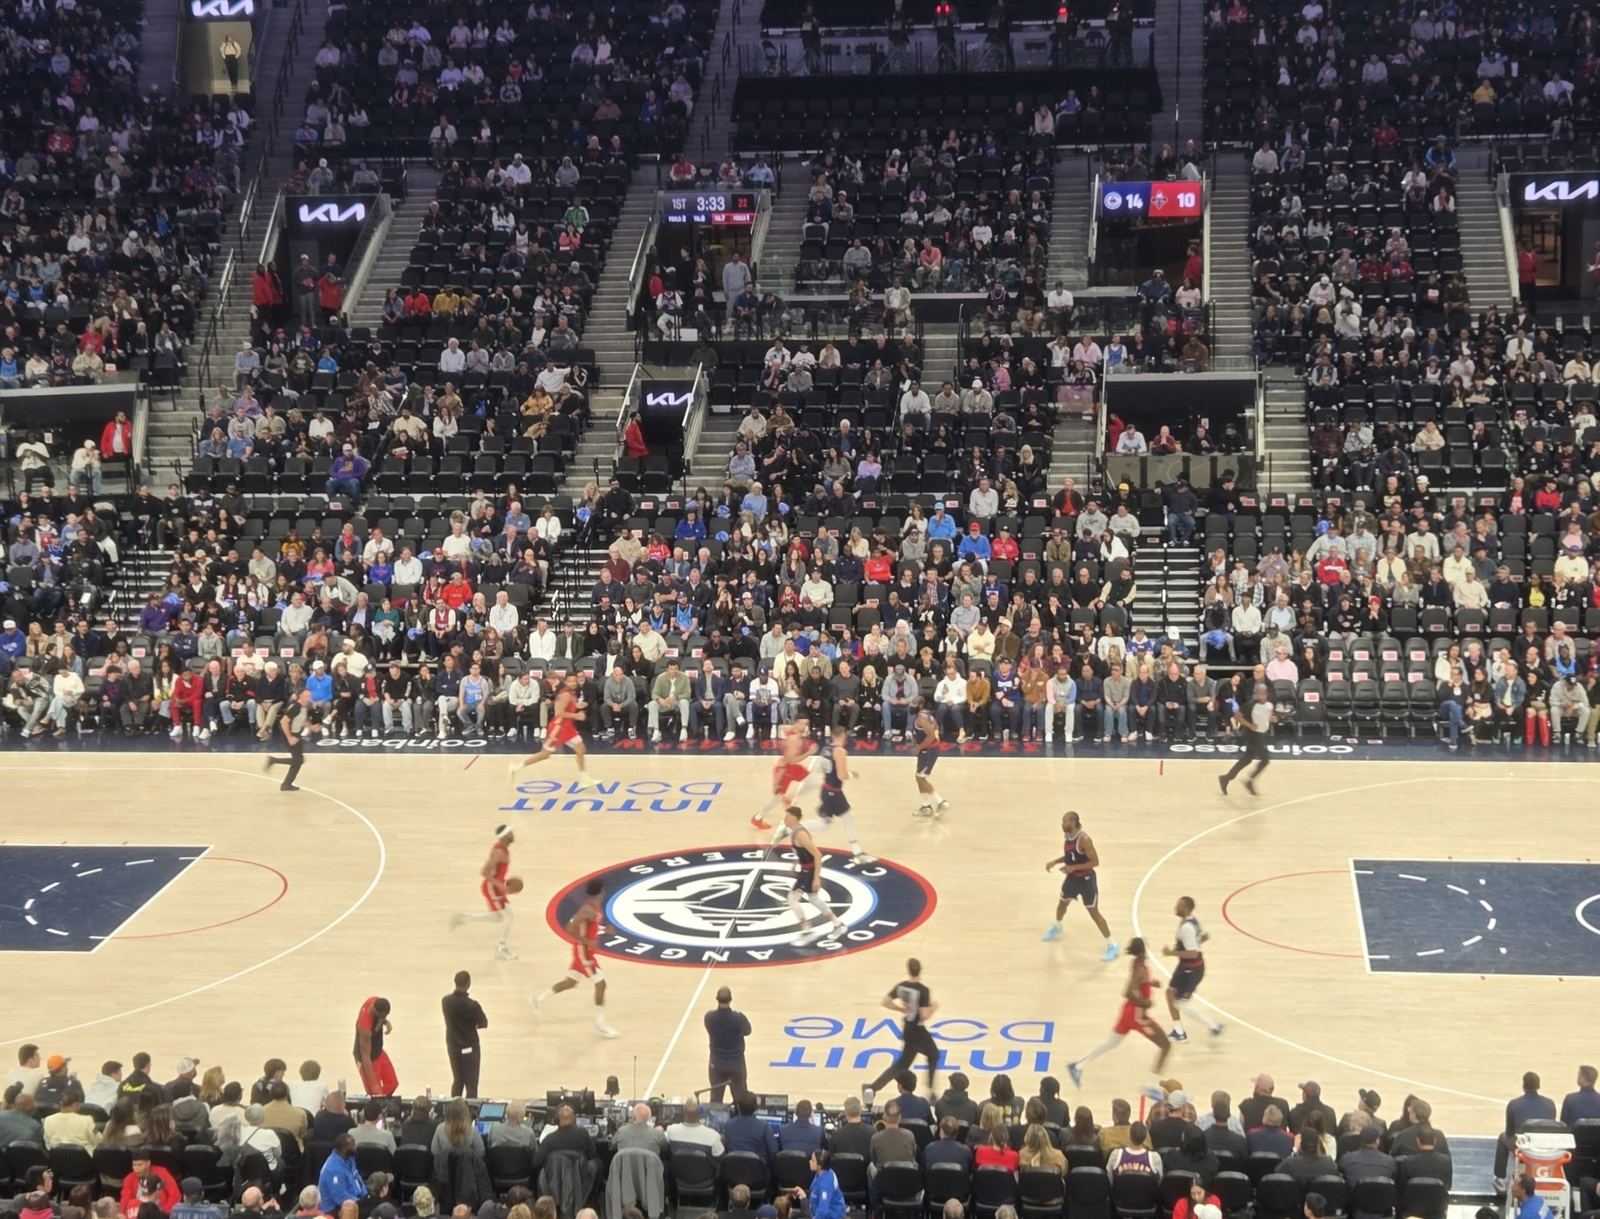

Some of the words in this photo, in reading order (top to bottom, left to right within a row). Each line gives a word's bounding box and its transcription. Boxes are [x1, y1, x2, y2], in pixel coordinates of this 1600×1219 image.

[1524, 180, 1599, 201] KIA
[671, 198, 687, 210] 1ST
[696, 196, 726, 212] 3:33
[737, 198, 748, 208] 22
[1125, 193, 1144, 209] 14
[1176, 192, 1196, 208] 10
[298, 202, 366, 222] KIA
[646, 392, 695, 406] KIA
[316, 738, 488, 749] coinbase
[1169, 744, 1354, 756] coinase
[497, 798, 713, 813] INTUIT
[597, 924, 775, 962] ANGEL
[816, 919, 900, 951] LOS
[768, 1046, 1050, 1073] INTUIT
[1536, 1166, 1549, 1178] G
